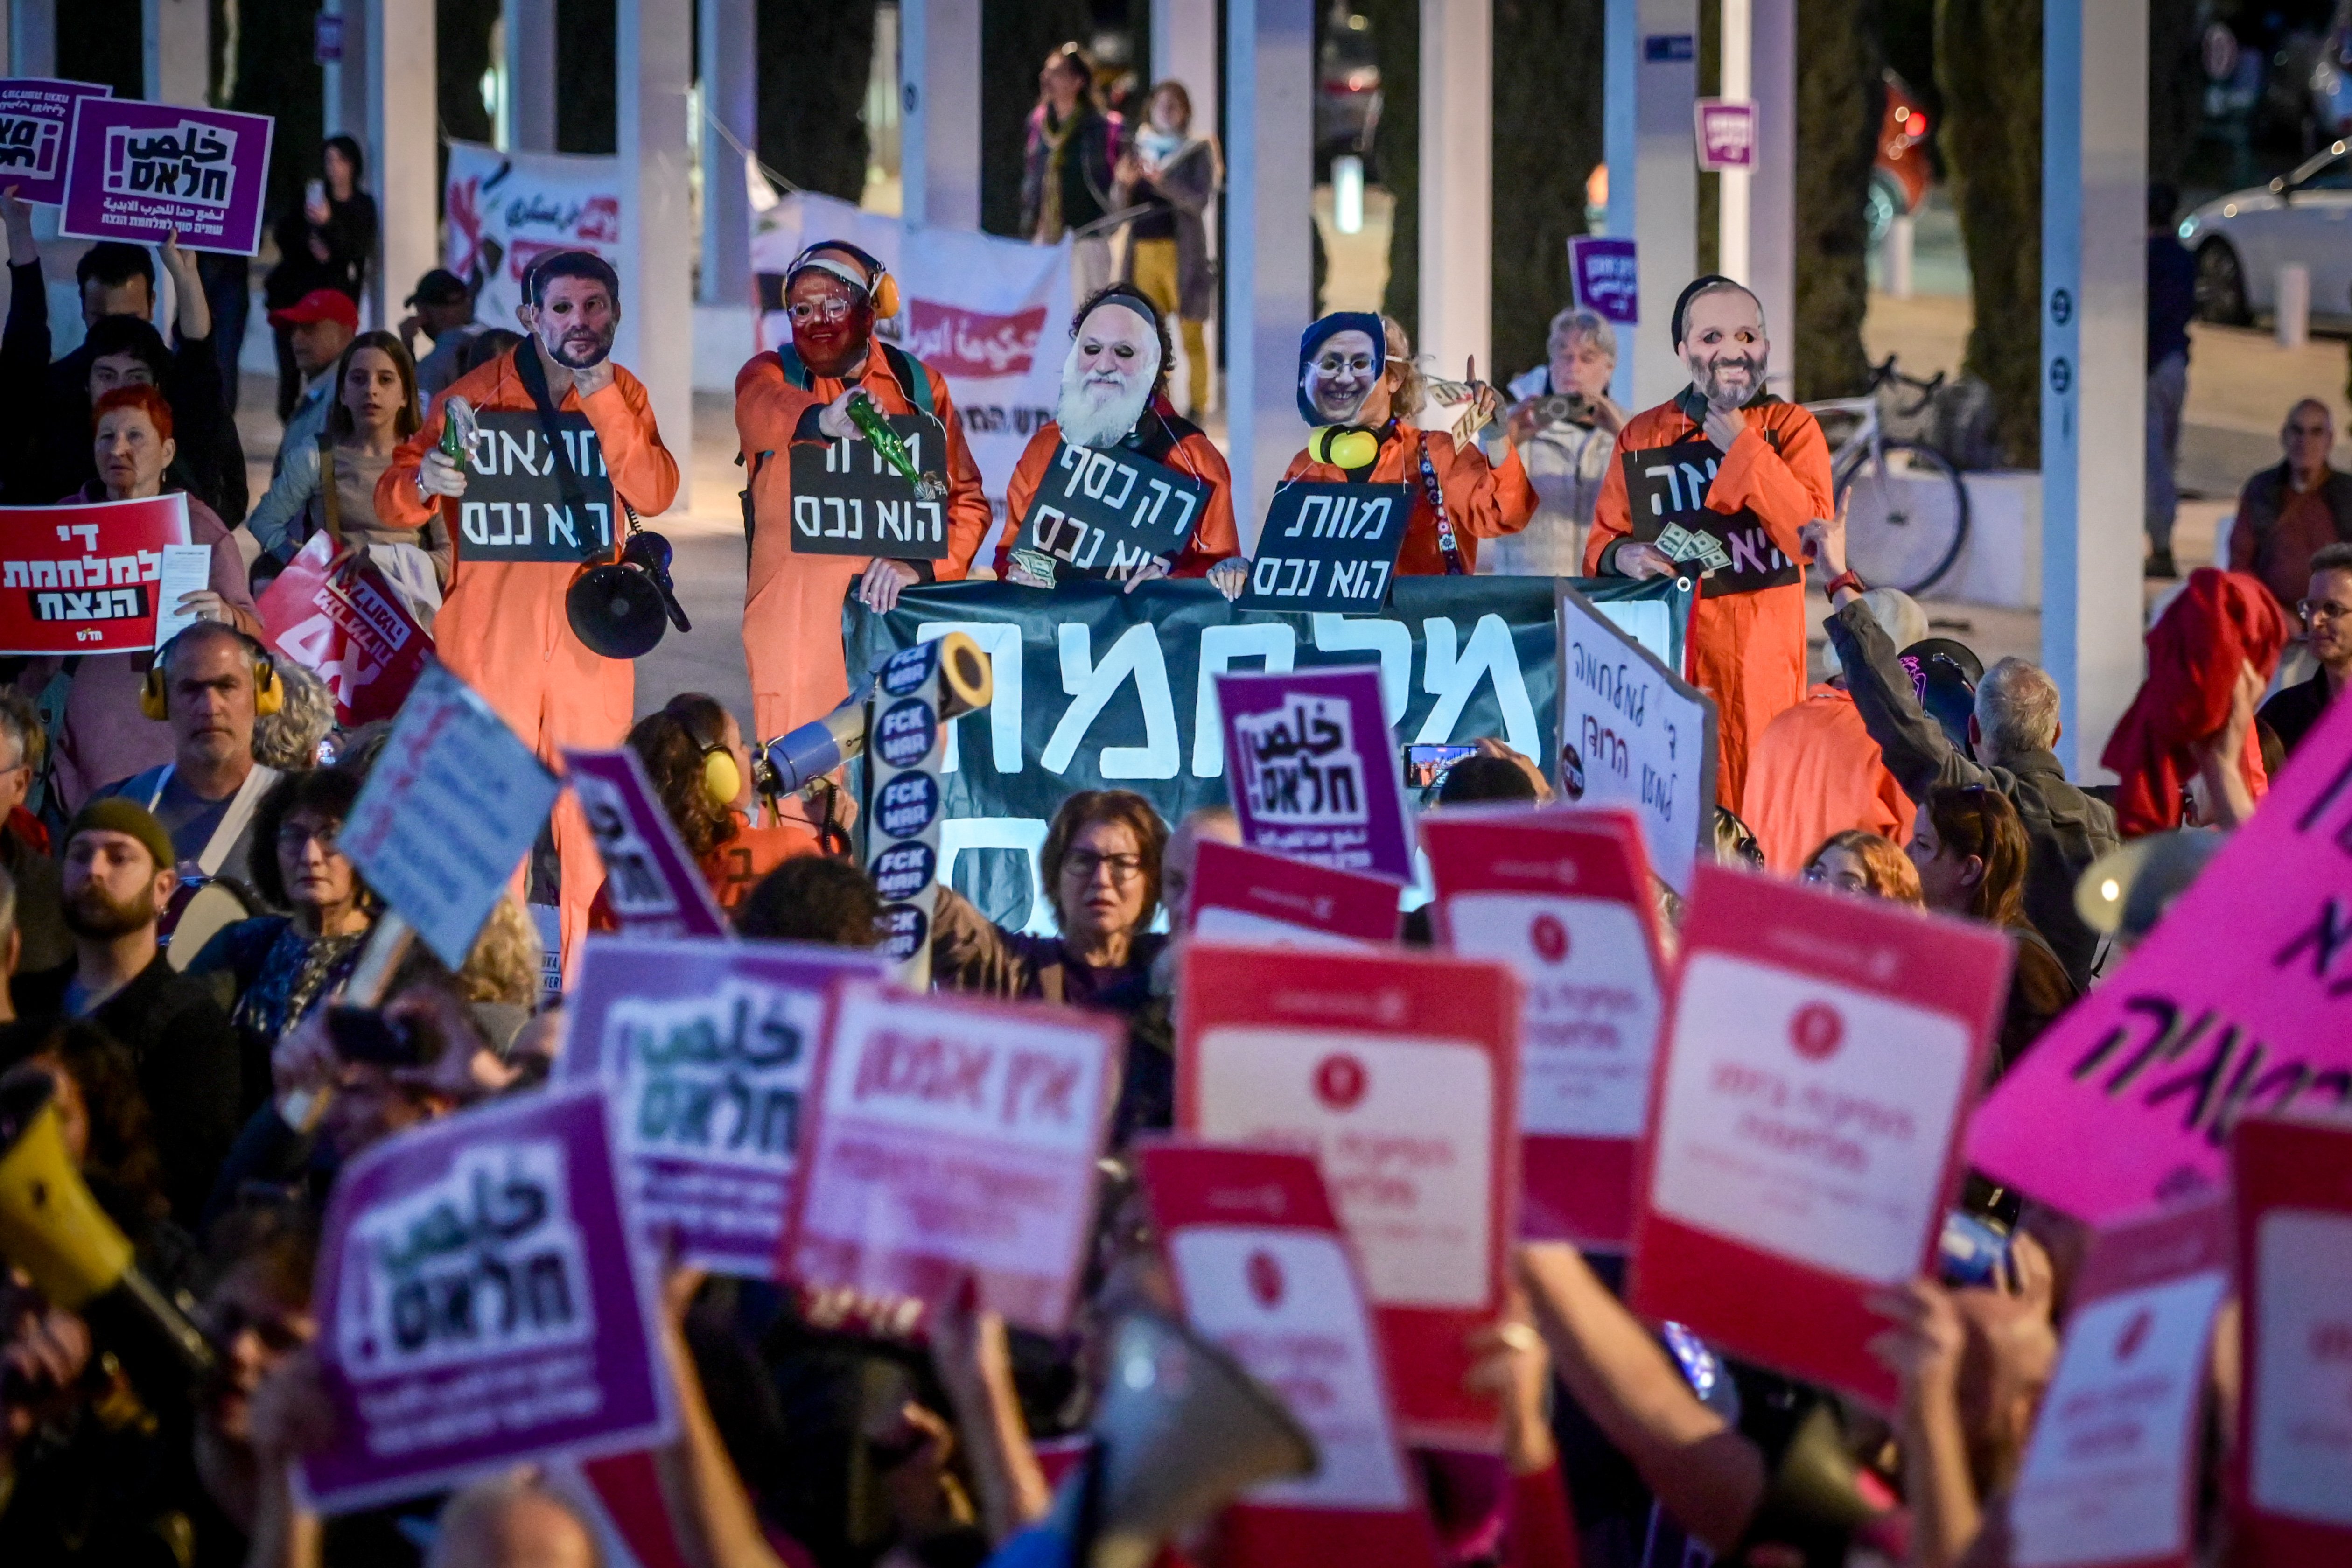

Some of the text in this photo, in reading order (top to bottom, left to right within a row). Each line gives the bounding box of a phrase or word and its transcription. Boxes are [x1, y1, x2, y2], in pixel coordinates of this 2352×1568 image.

[127, 128, 228, 162] خلص
[129, 158, 228, 202] חלאס
[1060, 444, 1197, 536] רק כסף
[56, 524, 99, 552] די
[462, 502, 609, 549] הא נכס
[794, 495, 863, 539] נכס
[876, 499, 942, 543] הוא
[1032, 504, 1105, 570] נכס
[1284, 495, 1393, 540] מוות
[3, 549, 163, 588] למלחמת
[1253, 557, 1391, 600] הוא נכס
[37, 588, 139, 621] הנצח
[1262, 755, 1358, 814] חלאס
